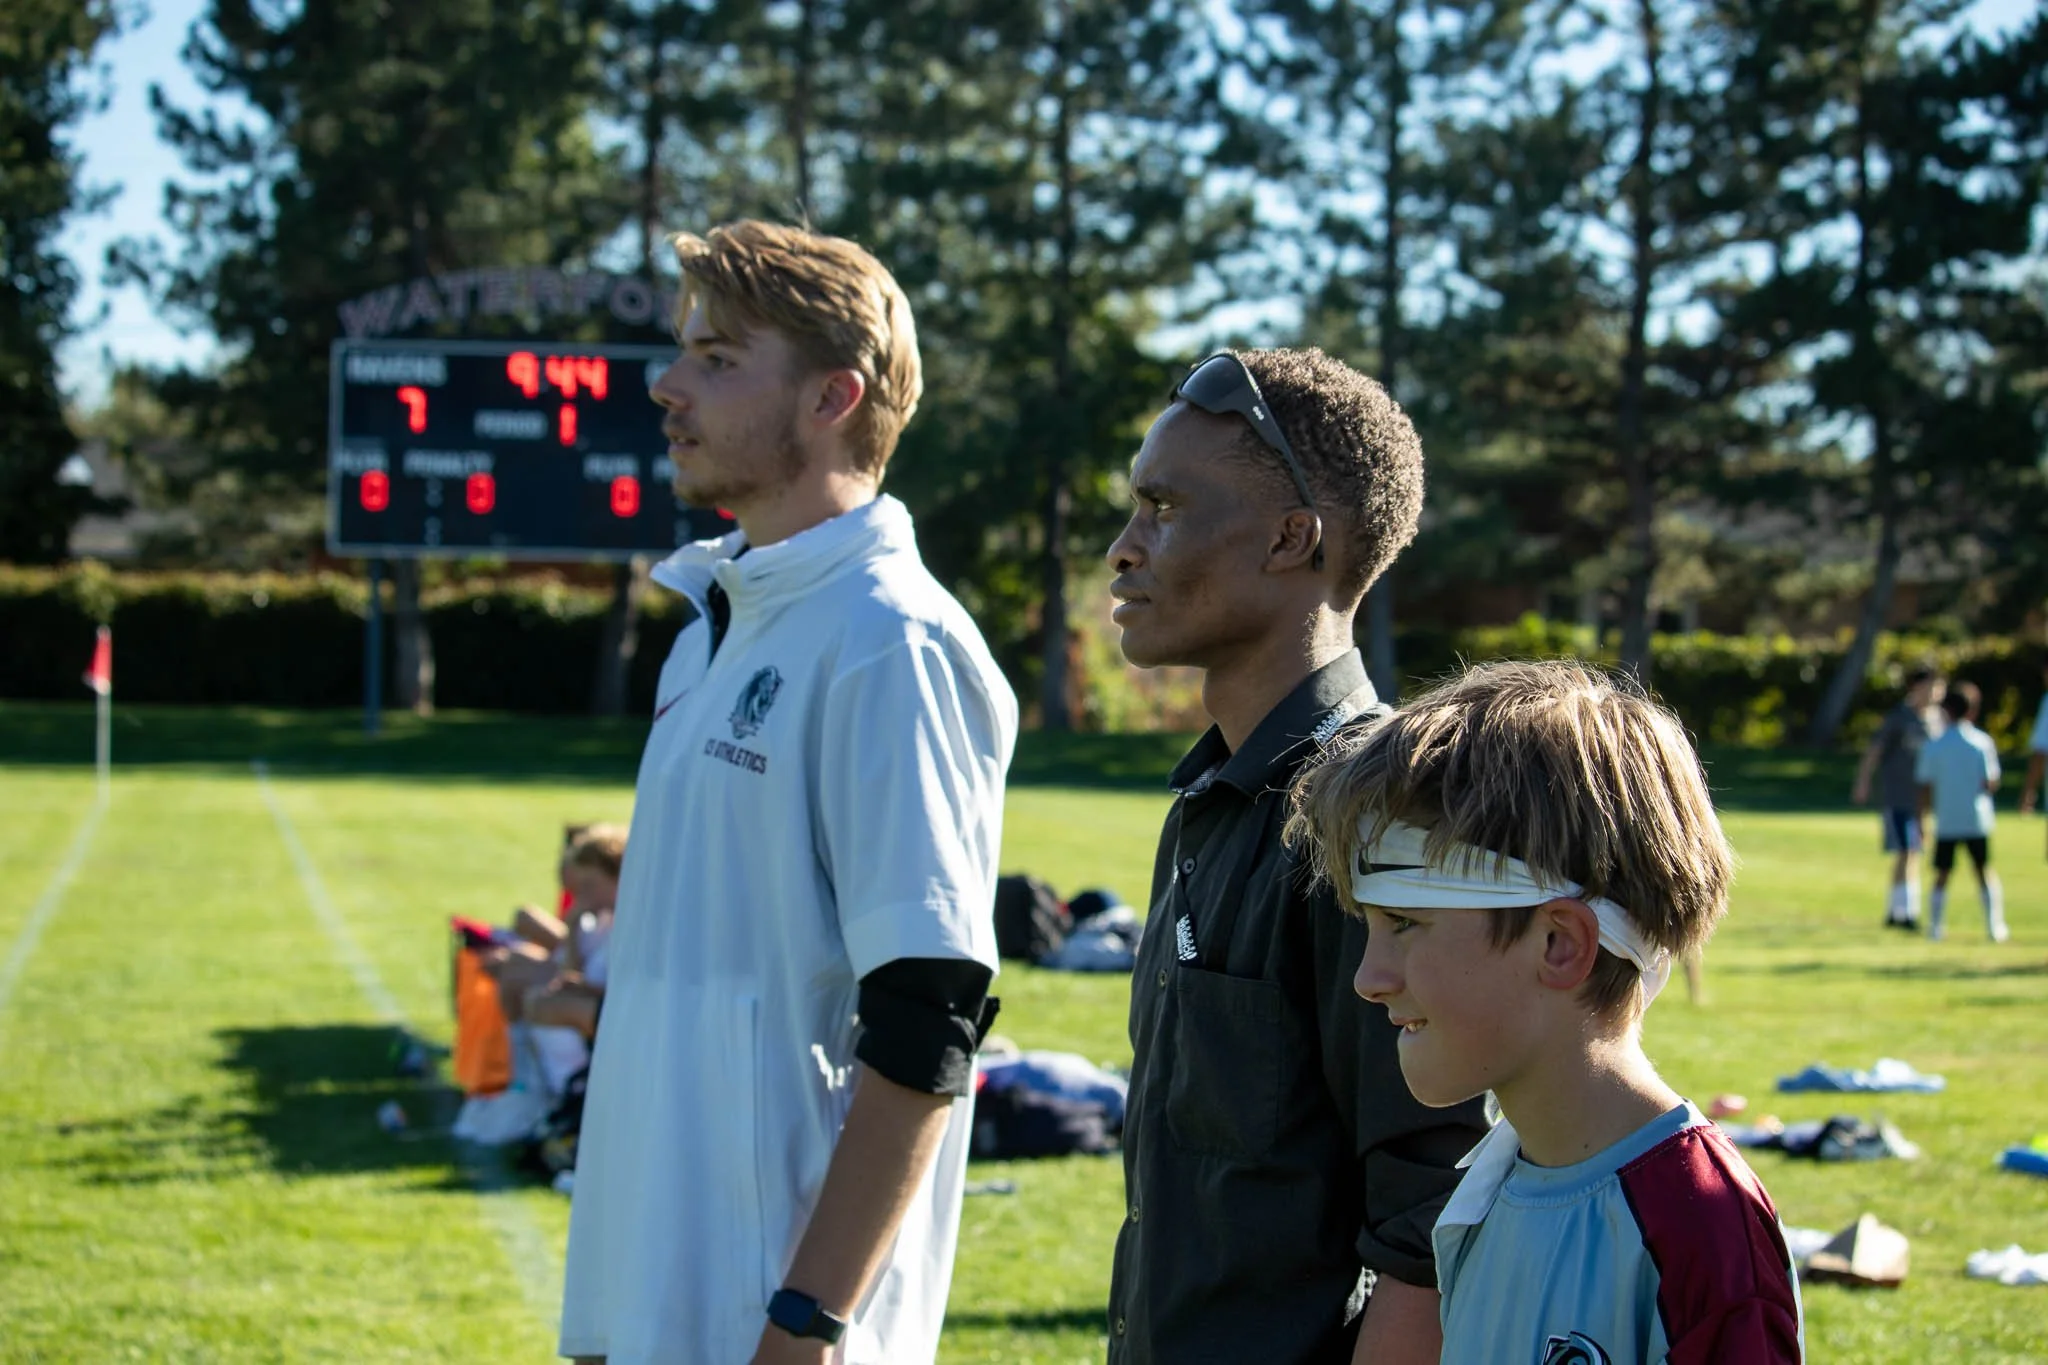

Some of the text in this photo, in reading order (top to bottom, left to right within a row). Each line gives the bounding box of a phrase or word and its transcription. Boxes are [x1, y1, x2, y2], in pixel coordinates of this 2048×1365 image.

[338, 269, 679, 336] WATERFO
[397, 385, 428, 434] 7
[558, 403, 577, 447] 1
